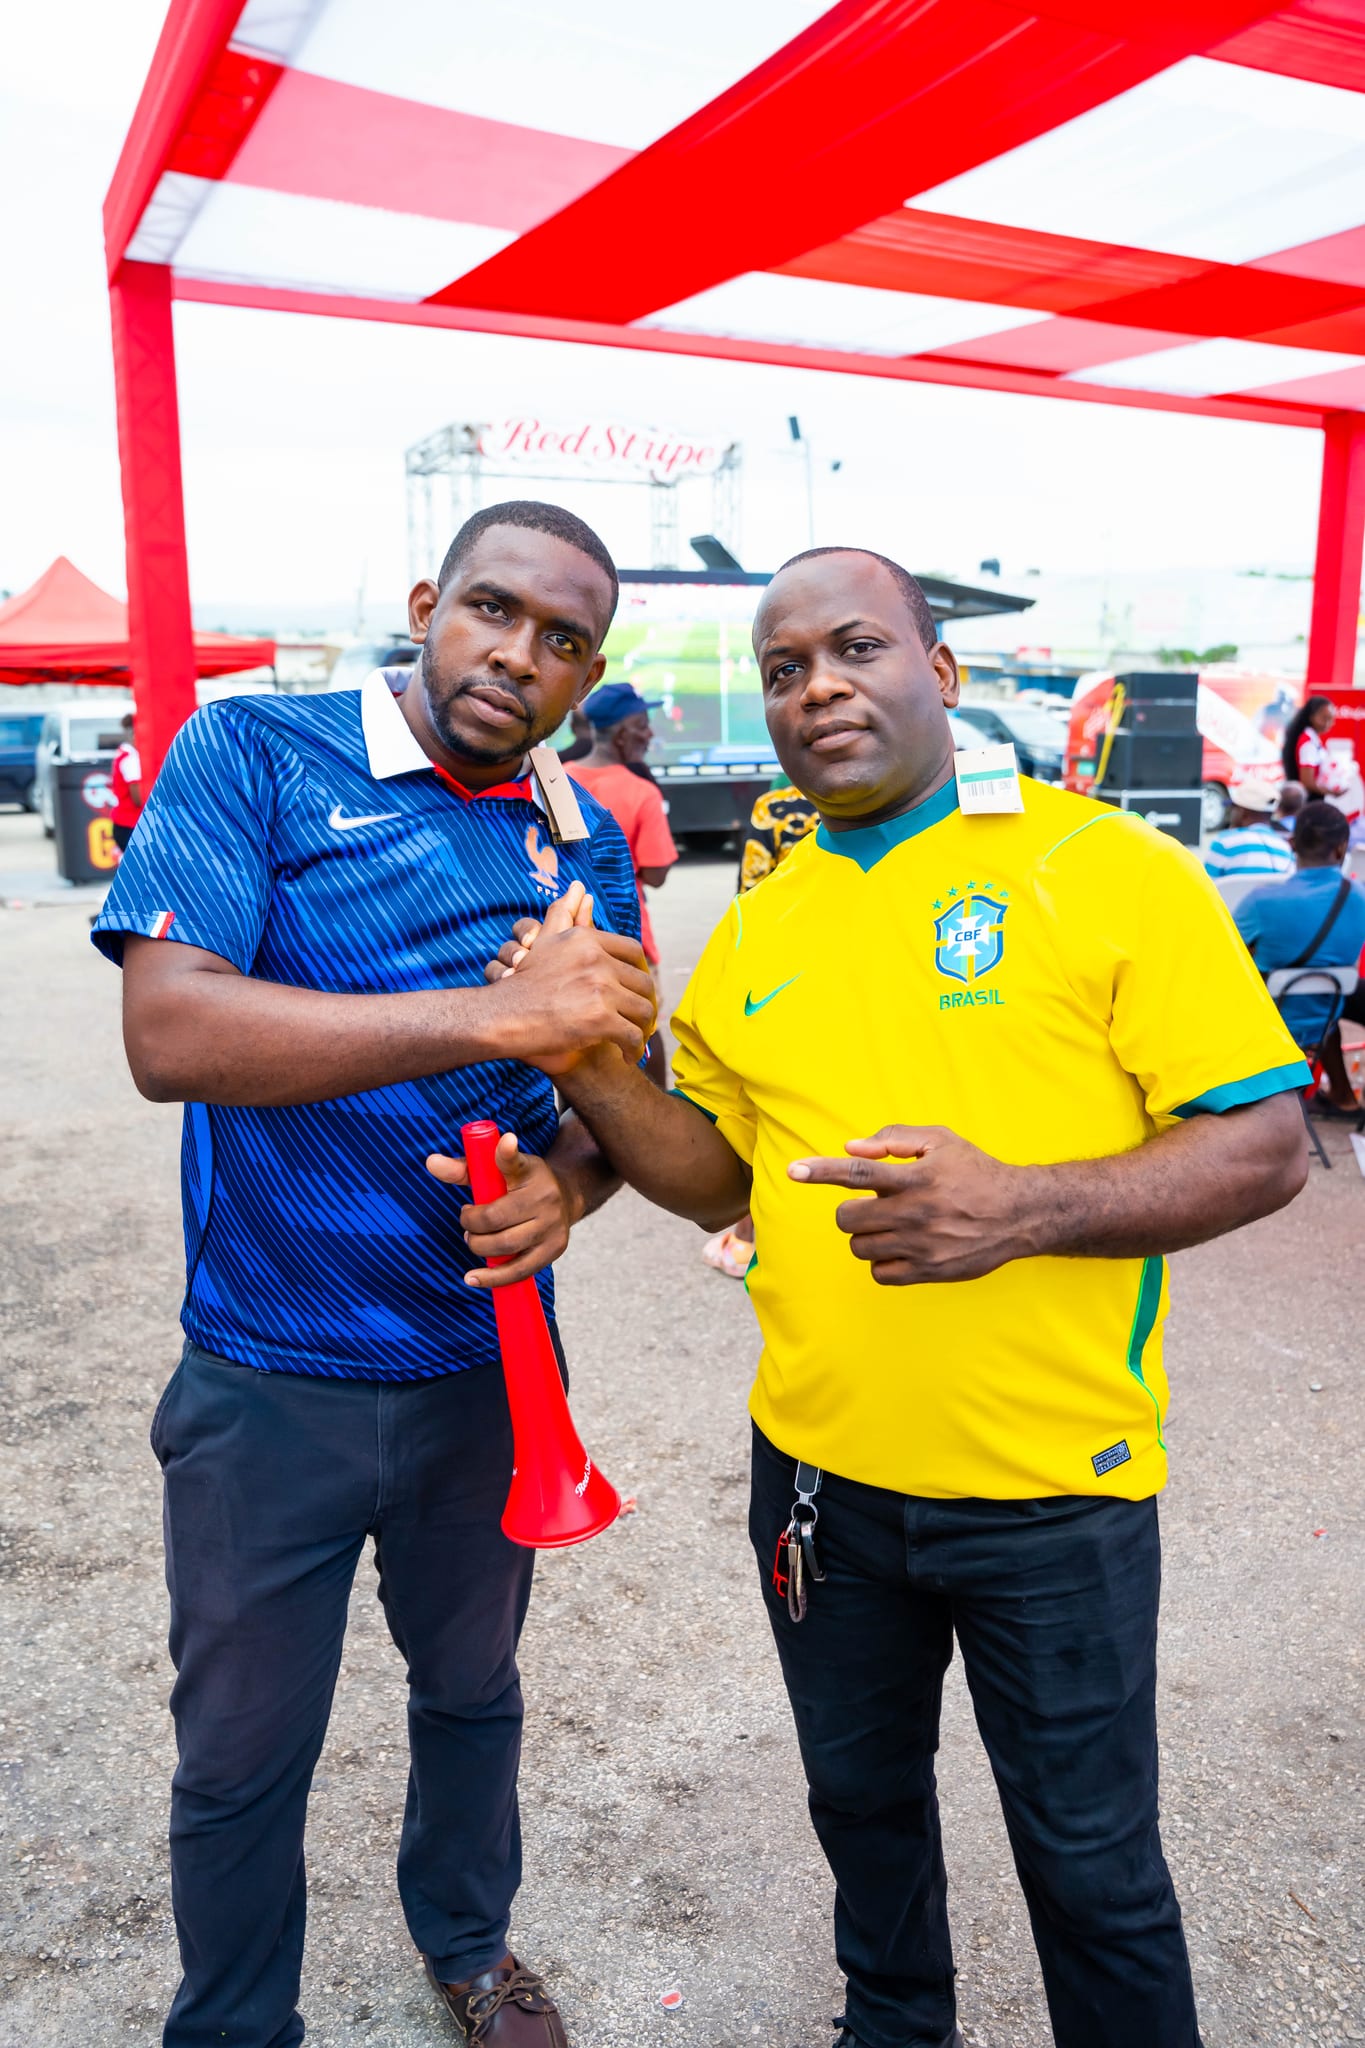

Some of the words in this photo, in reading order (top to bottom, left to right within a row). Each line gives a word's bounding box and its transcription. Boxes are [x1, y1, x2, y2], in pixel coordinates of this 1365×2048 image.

[504, 417, 591, 454] Red
[594, 426, 715, 472] Stripe
[954, 928, 982, 942] CBF
[939, 989, 1005, 1010] BRASIL
